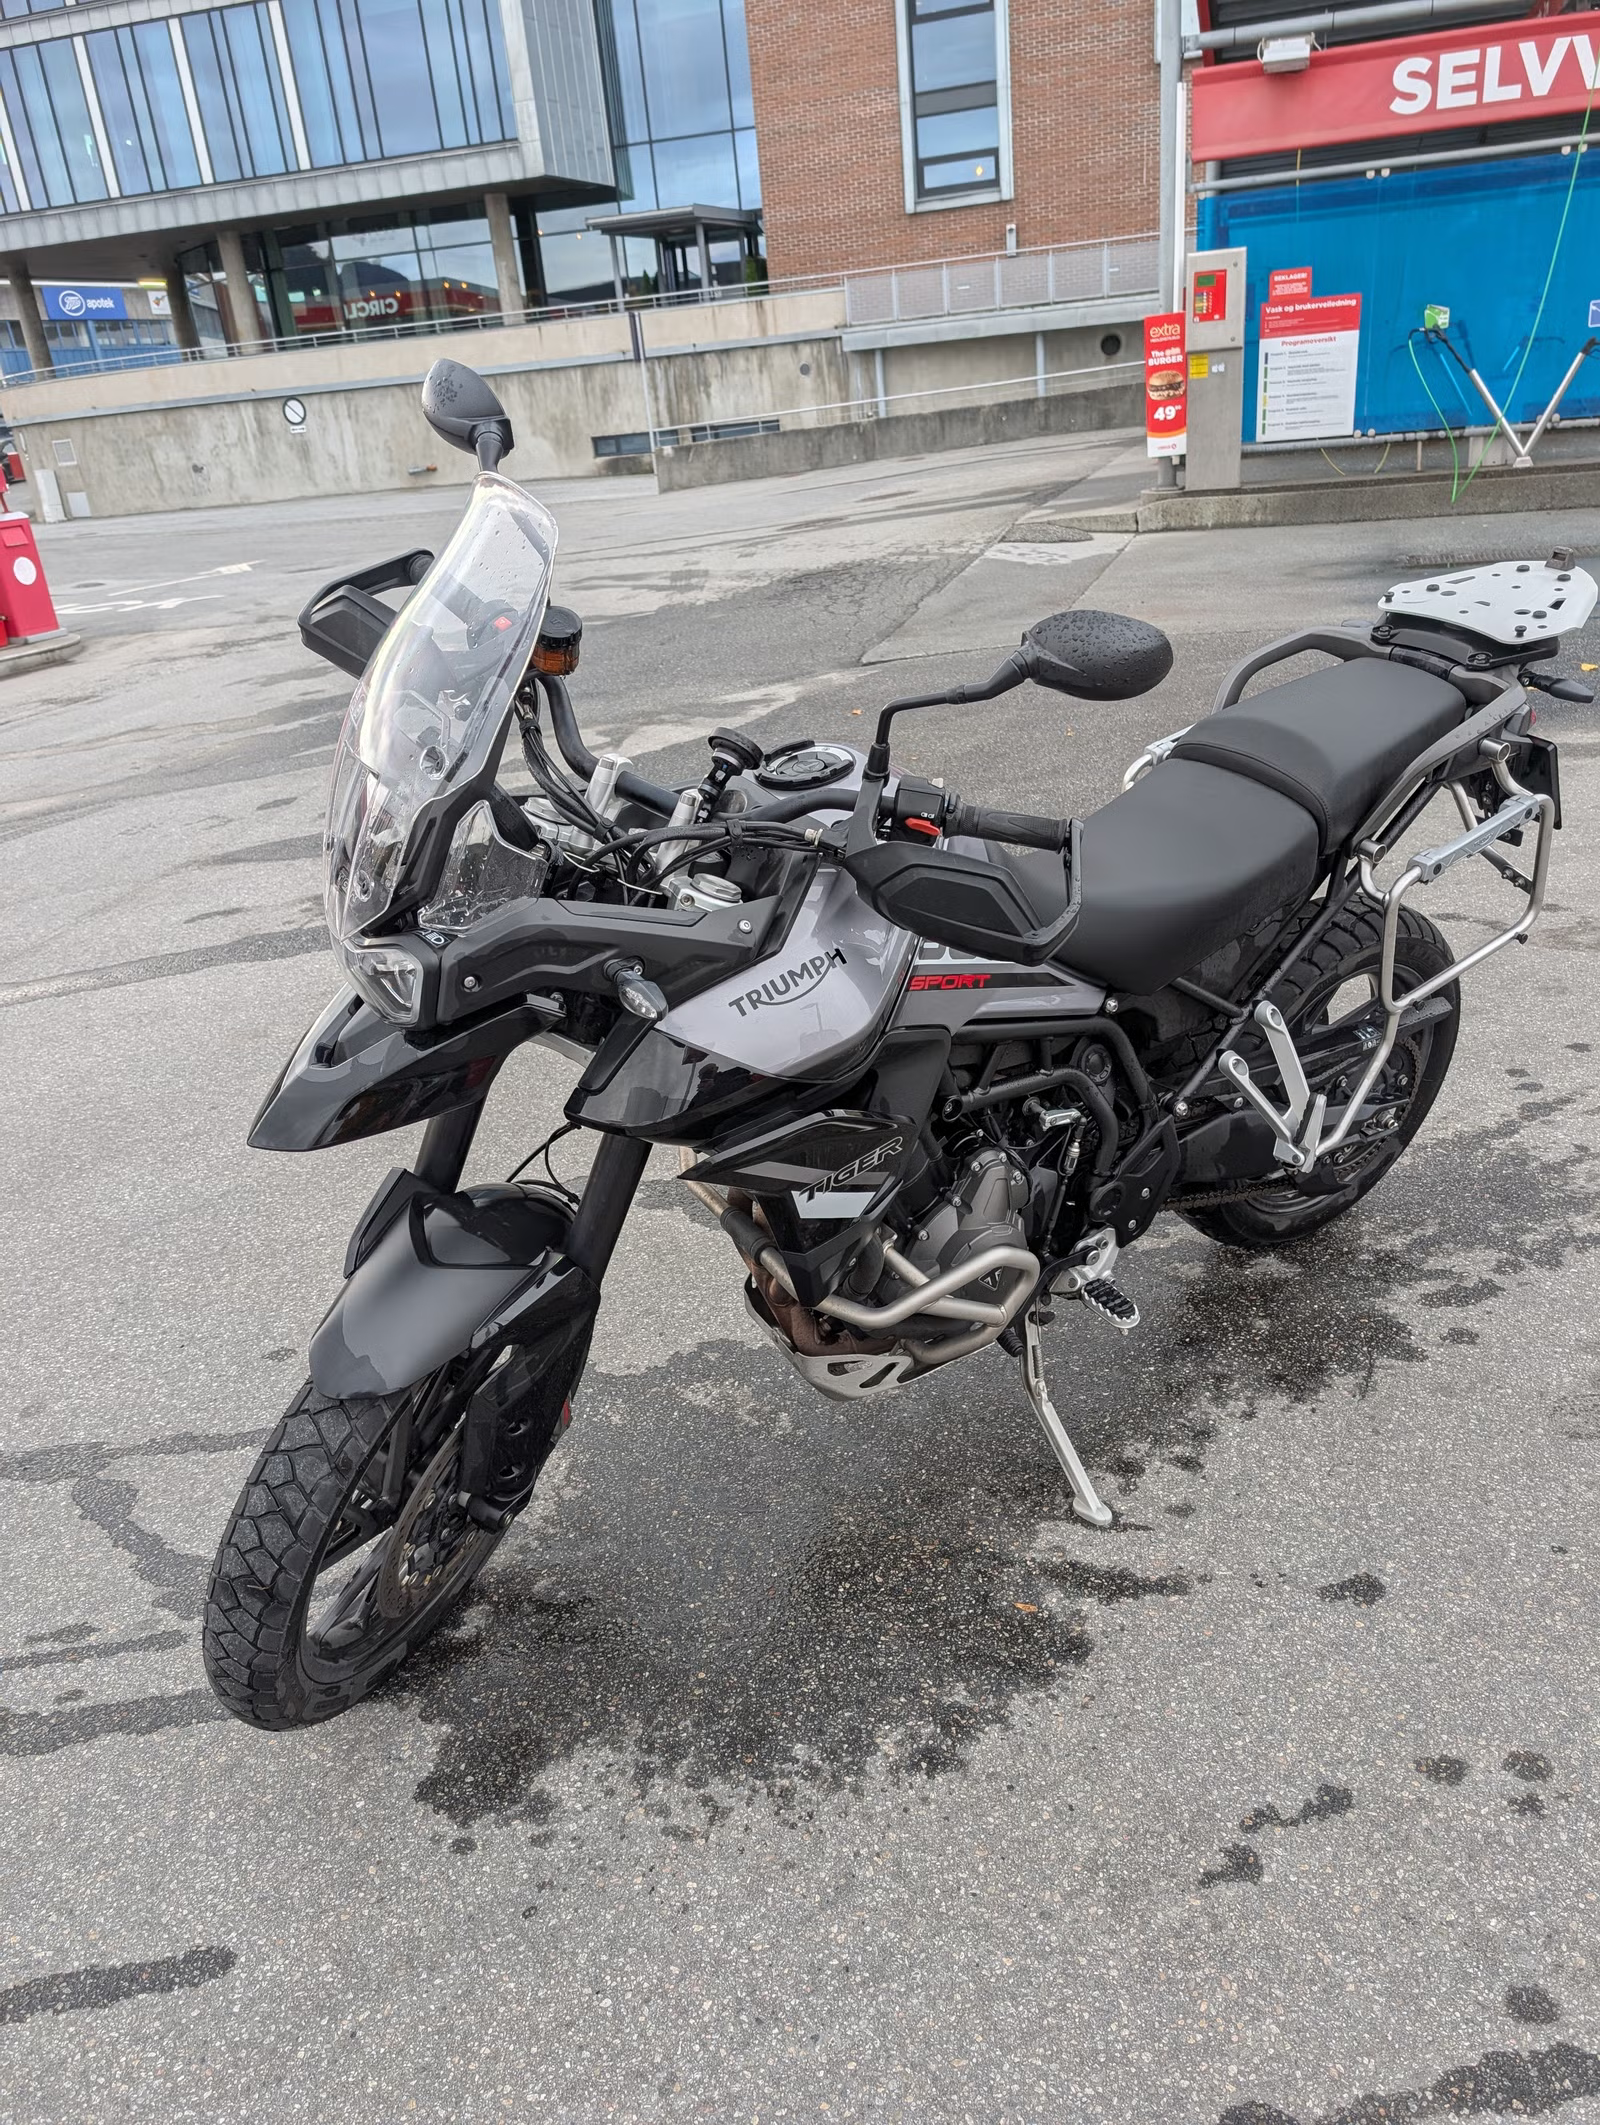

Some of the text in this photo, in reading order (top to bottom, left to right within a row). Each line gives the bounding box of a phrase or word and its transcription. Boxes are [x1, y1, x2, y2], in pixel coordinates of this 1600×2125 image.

[87, 297, 115, 310] apotek
[1265, 298, 1357, 314] Vask og brukerveiledning
[1150, 323, 1181, 338] extra
[1281, 336, 1337, 347] Programoversikt
[1148, 354, 1184, 367] BURGER
[1151, 350, 1165, 358] The
[728, 948, 847, 1017] TRIUMPH
[909, 974, 991, 991] SPORT
[798, 1136, 903, 1203] TIGER
